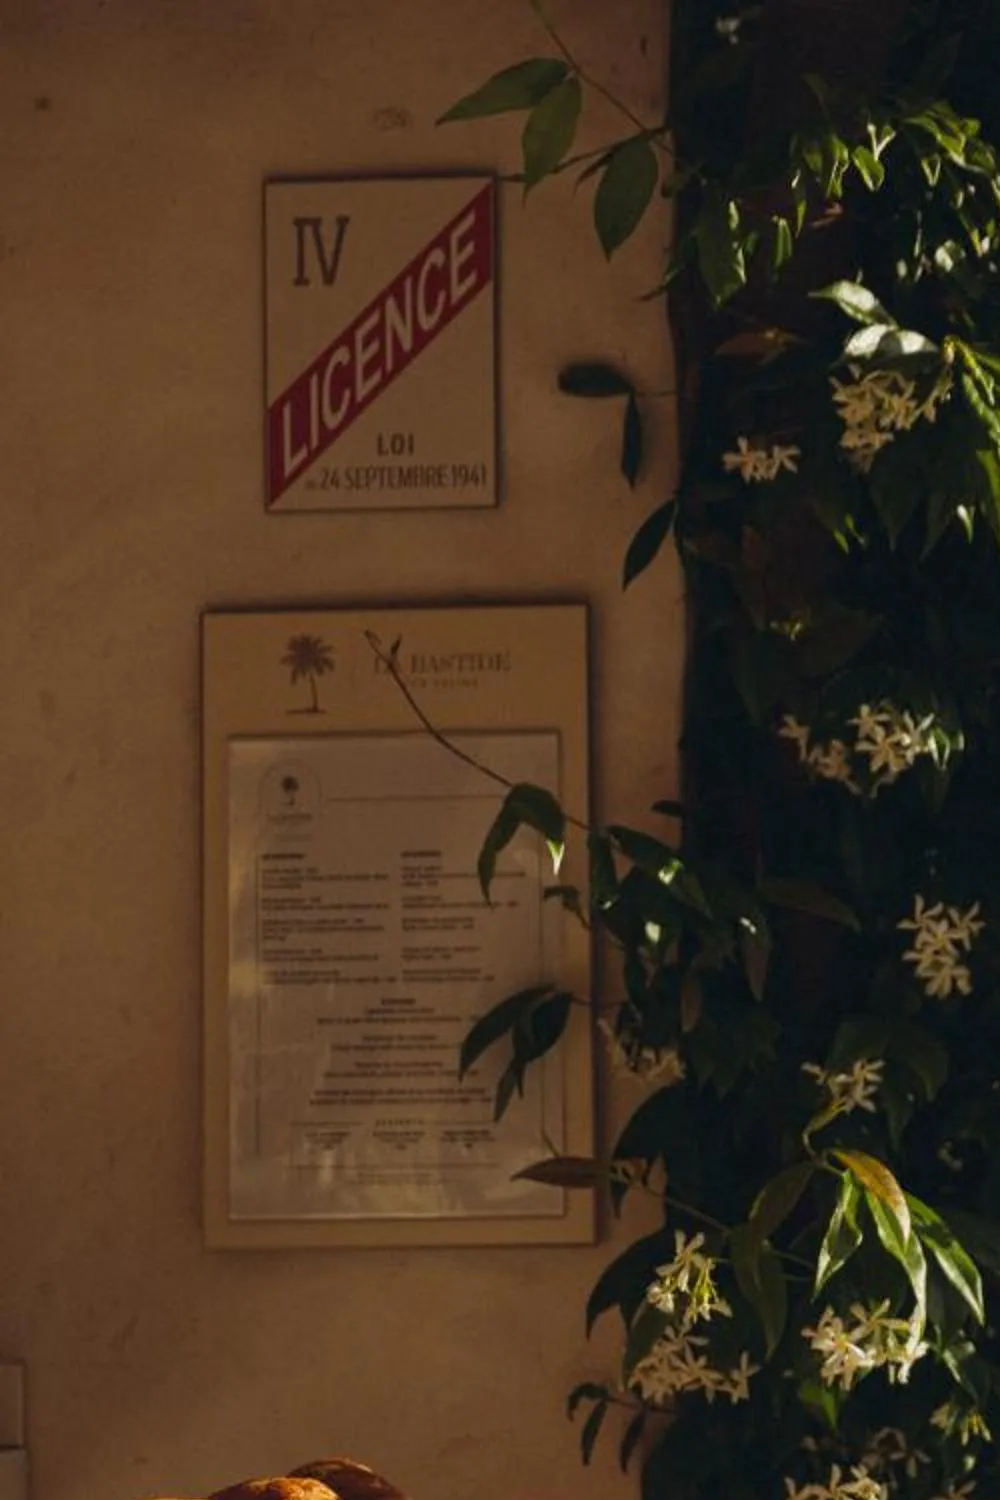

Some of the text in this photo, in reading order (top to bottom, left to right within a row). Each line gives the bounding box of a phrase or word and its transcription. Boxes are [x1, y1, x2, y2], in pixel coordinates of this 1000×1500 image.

[292, 216, 351, 287] IV
[282, 211, 478, 481] LICENCE
[376, 433, 415, 456] LOI
[319, 466, 341, 490] 24
[344, 464, 449, 490] SEPTEMBRE
[450, 462, 488, 488] 1941
